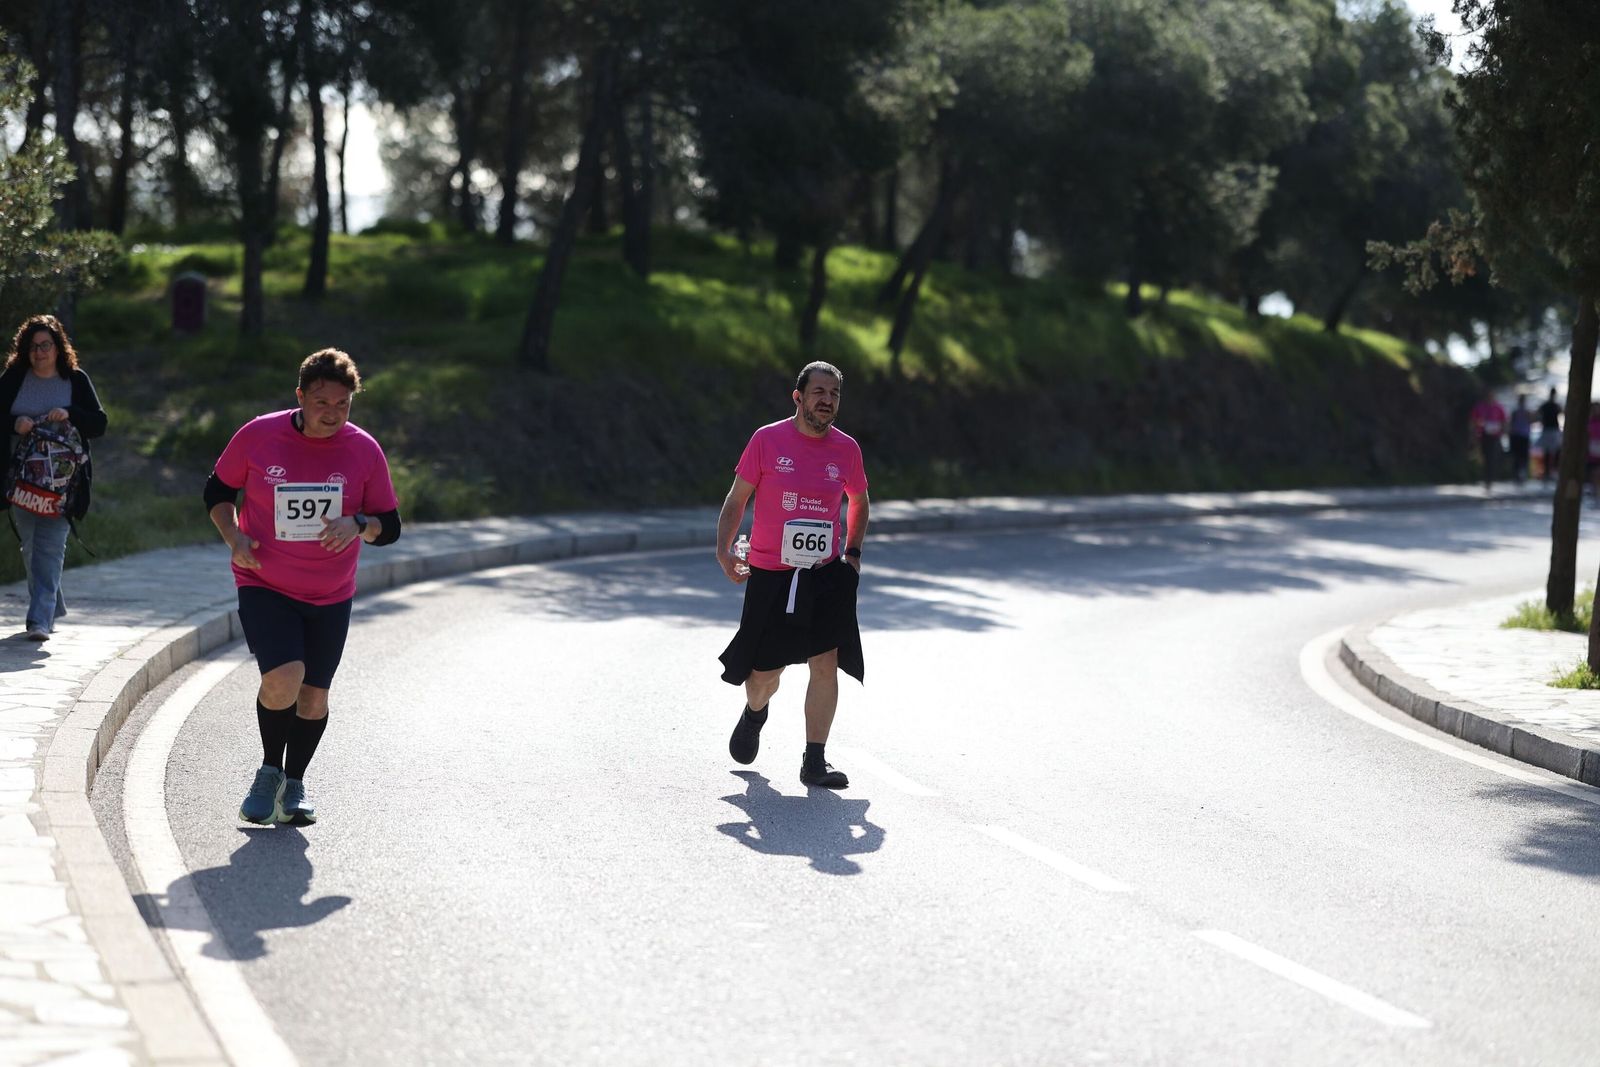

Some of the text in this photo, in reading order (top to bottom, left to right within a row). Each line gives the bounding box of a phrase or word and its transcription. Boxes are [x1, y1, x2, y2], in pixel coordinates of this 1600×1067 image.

[11, 487, 55, 513] MARVEL
[287, 499, 332, 520] 597
[800, 497, 822, 505] Ciudad
[808, 504, 829, 513] Málaga
[792, 532, 827, 552] 666
